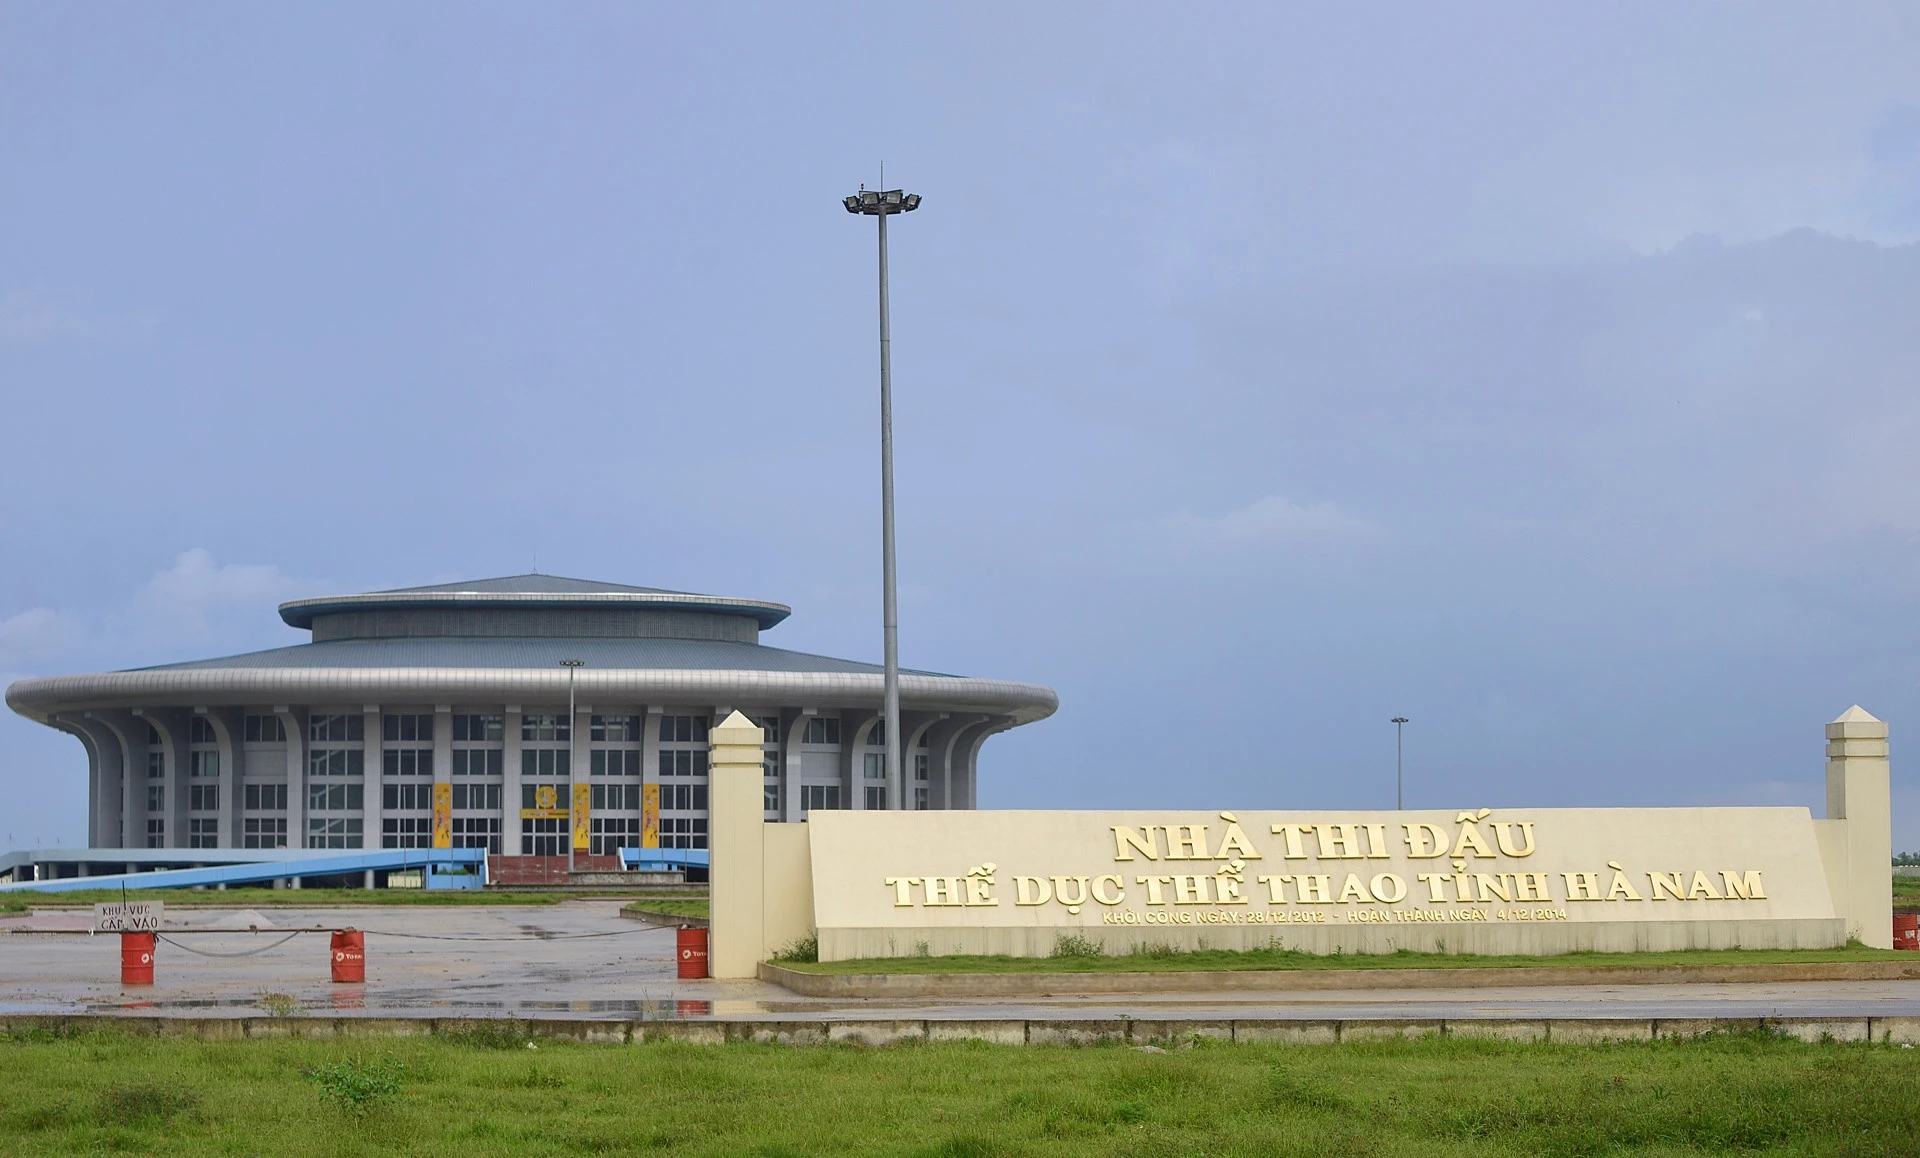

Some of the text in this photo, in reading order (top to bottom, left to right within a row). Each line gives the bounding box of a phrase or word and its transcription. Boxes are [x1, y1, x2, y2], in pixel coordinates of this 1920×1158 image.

[1109, 807, 1537, 861] NHÀ THI ĐẤU
[885, 859, 1768, 915] THỂ DỤC THỂ THAO TỈNH HÀ NAM
[102, 906, 121, 916] KHU
[1103, 908, 1142, 924] KHỞI
[1145, 910, 1191, 923] CÔNG
[1246, 910, 1326, 923] 28/12/2012
[1347, 907, 1391, 922] HOÀN
[1394, 907, 1446, 922] THÀNH
[1450, 907, 1489, 922] NGÀY
[1497, 908, 1568, 921] 4/12/2014
